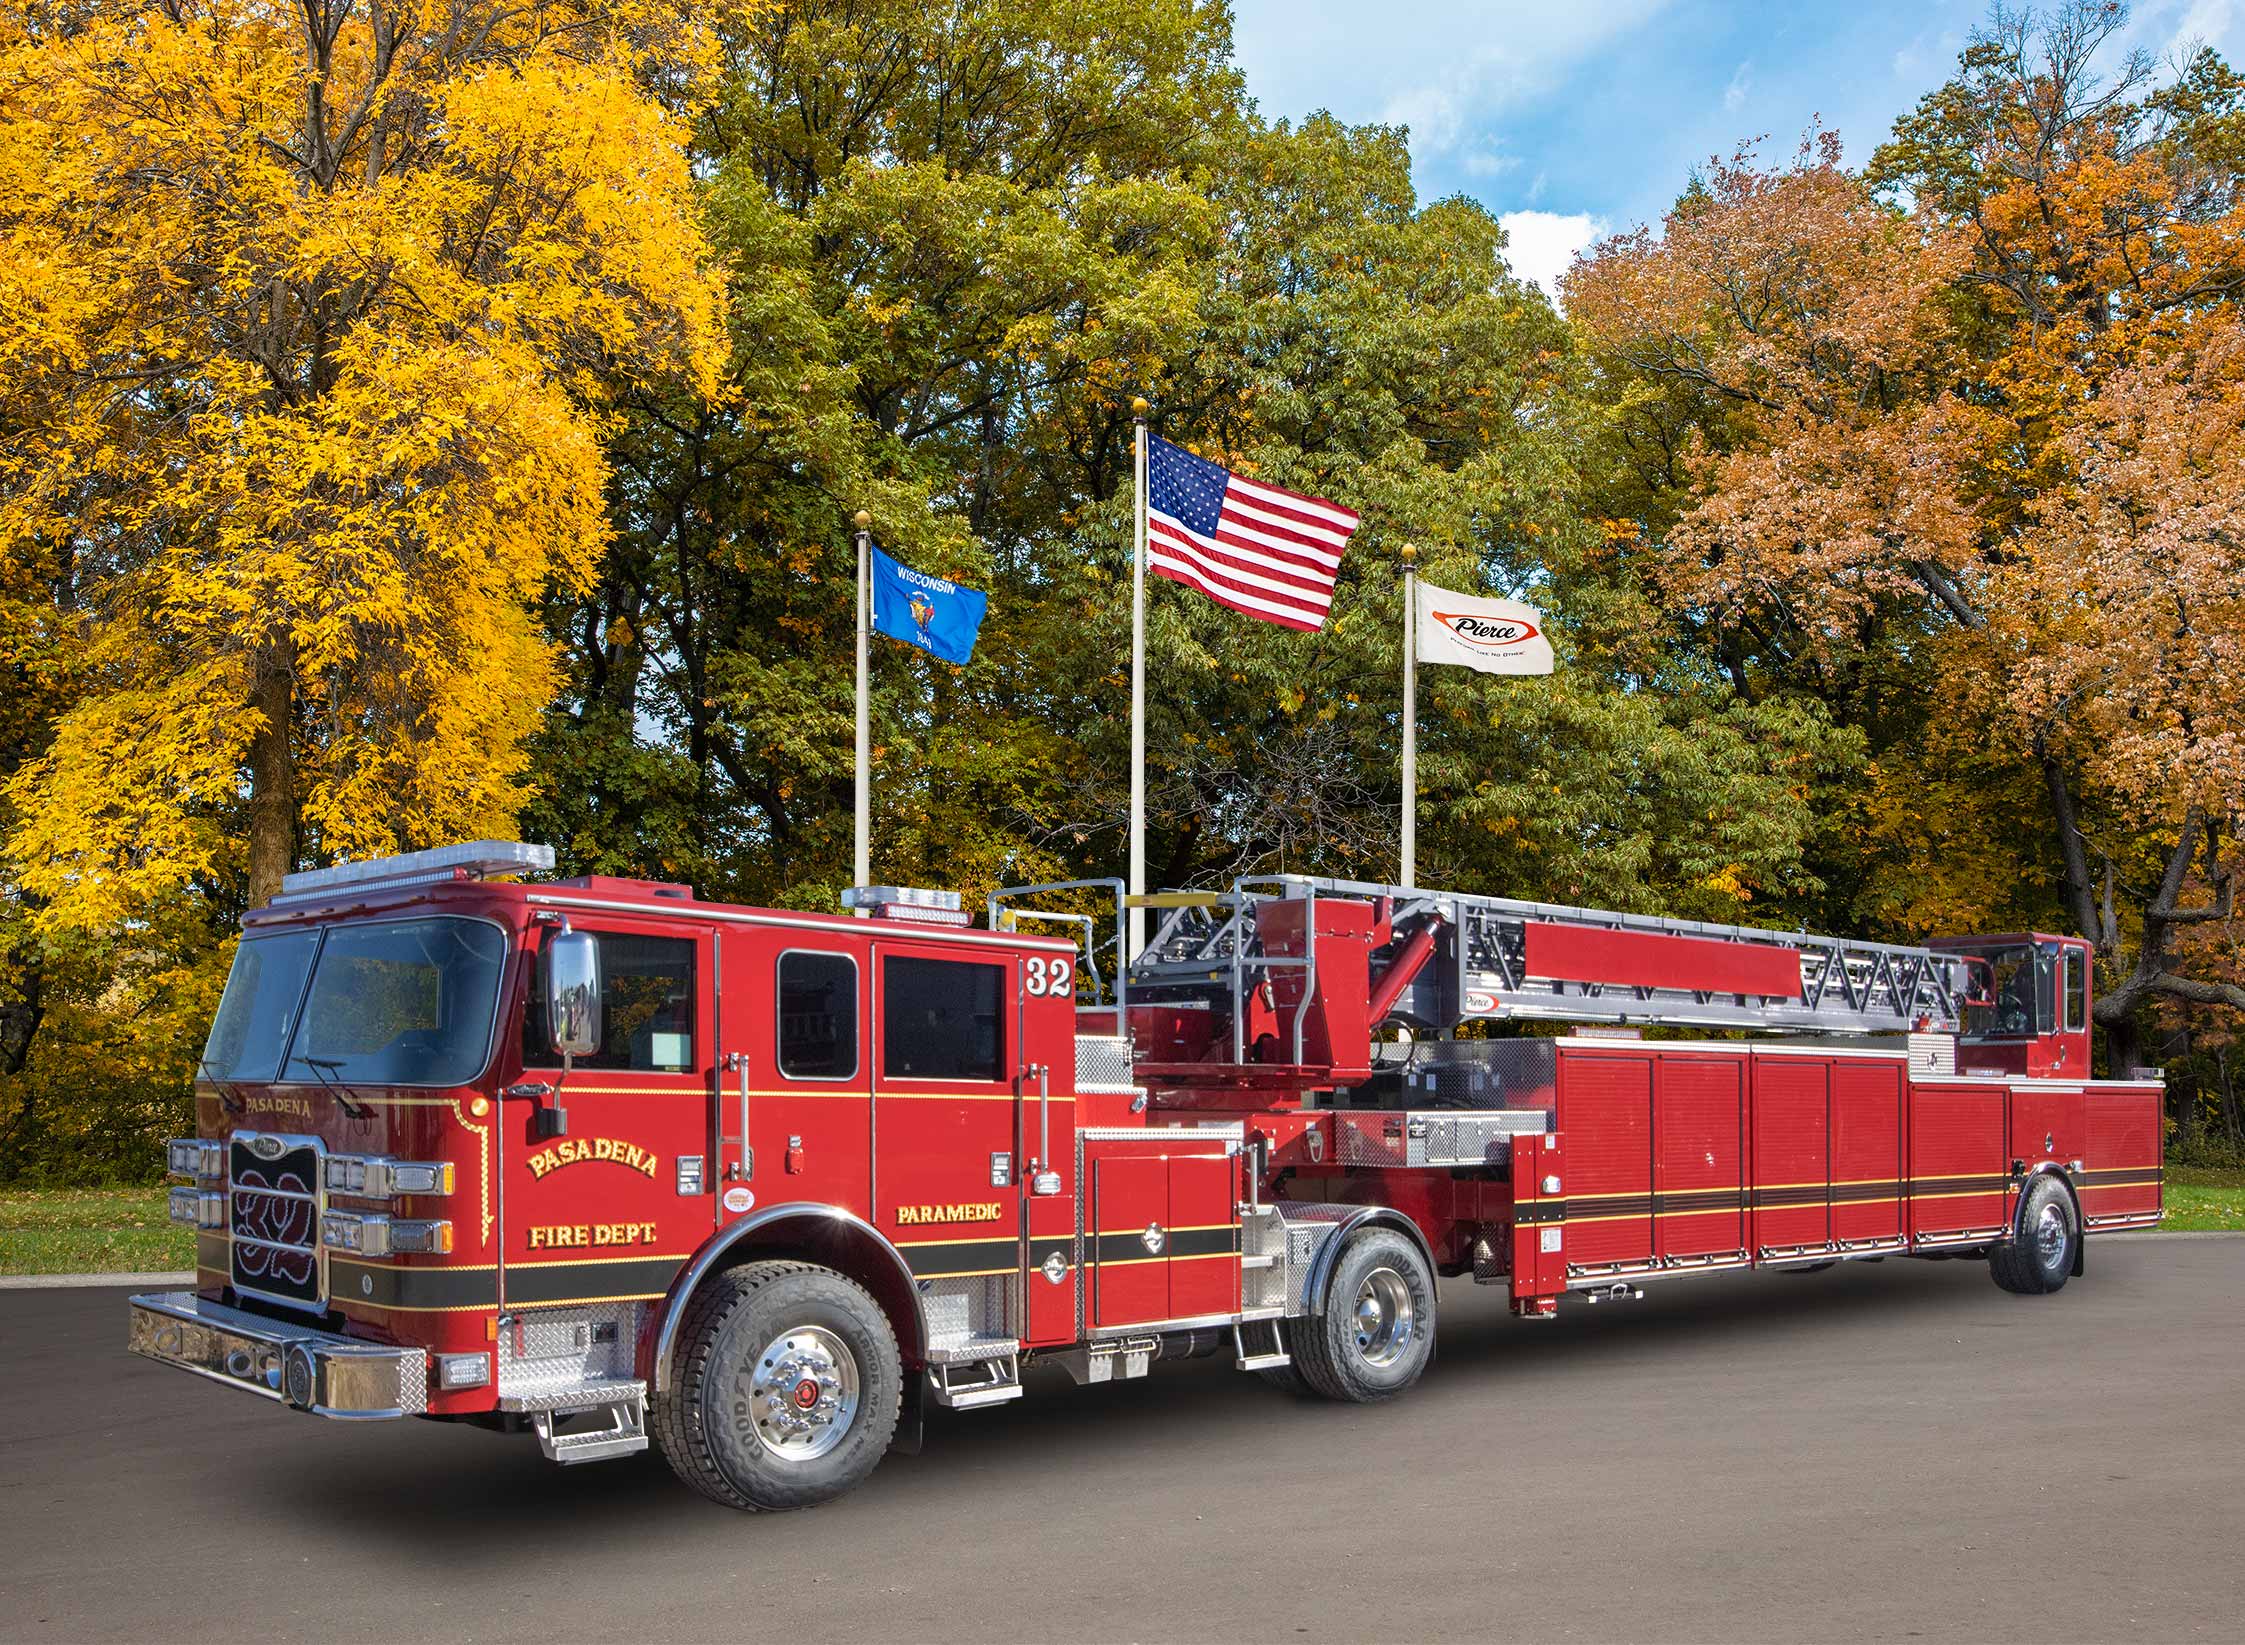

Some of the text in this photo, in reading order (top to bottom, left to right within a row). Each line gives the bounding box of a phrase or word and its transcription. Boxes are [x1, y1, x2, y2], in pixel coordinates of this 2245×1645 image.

[897, 566, 956, 595] WISCONSIN
[1455, 617, 1517, 639] Pierce
[1027, 956, 1071, 998] 32
[246, 1097, 311, 1118] PASADENA
[527, 1137, 657, 1180] PASADENA
[897, 1202, 1002, 1226] PARAMEDIC
[528, 1221, 657, 1250] FIRE DEPT.
[863, 1392, 880, 1434] MAX
